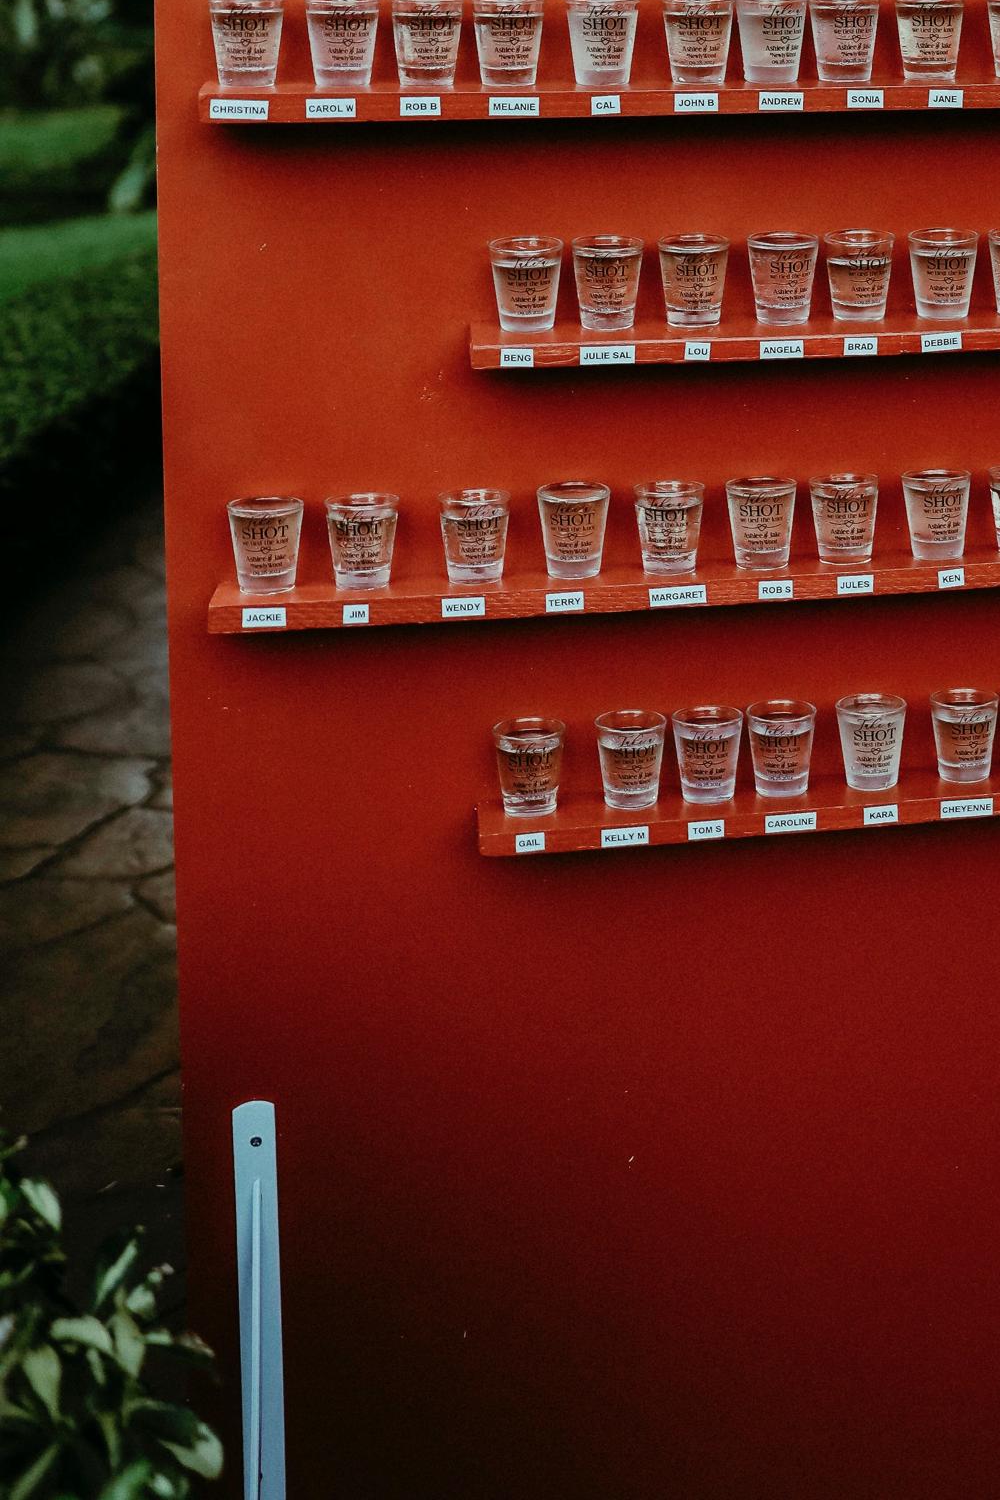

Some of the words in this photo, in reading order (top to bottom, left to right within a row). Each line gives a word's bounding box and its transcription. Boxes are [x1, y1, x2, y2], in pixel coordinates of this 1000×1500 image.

[223, 19, 269, 31] SHOT
[325, 18, 370, 30] SHOT
[492, 17, 534, 30] SHOT
[583, 18, 627, 30] SHOT
[678, 17, 722, 29] SHOT
[763, 16, 802, 29] SHOT
[912, 15, 954, 27] SHOT
[678, 99, 705, 107] JOHN
[761, 97, 801, 106] ANDREW
[851, 95, 881, 104] SONIA
[932, 95, 958, 103] JANE
[212, 105, 266, 115] CHRISTINA
[308, 104, 344, 113] CAROL
[405, 102, 428, 111] ROB
[493, 102, 536, 111] MELANIE
[595, 101, 616, 110] CAL
[770, 260, 812, 273] SHOT
[927, 257, 968, 270] SHOT
[508, 269, 550, 281] SHOT
[676, 264, 719, 277] SHOT
[847, 342, 874, 351] BRAD
[924, 337, 959, 348] DEBBIE
[687, 347, 708, 356] LOU
[763, 345, 802, 354] ANGELA
[503, 354, 532, 362] BENG
[583, 351, 610, 360] JULIE
[612, 351, 632, 359] SAL
[923, 494, 963, 507] SHOT
[739, 504, 783, 517] SHOT
[550, 512, 596, 526] SHOT
[242, 525, 289, 540] SHOT
[942, 574, 961, 584] KEN
[762, 586, 783, 594] ROB
[839, 580, 870, 590] JULES
[651, 590, 704, 602] MARGARET
[445, 602, 481, 612] WENDY
[548, 597, 581, 607] TERRY
[246, 613, 281, 622] JACKIE
[349, 610, 366, 619] JIM
[952, 722, 991, 736] SHOT
[854, 728, 896, 741] SHOT
[687, 740, 728, 755] SHOT
[943, 803, 991, 814] CHEYENNE
[869, 810, 895, 820] KARA
[767, 817, 814, 828] CAROLINE
[692, 826, 713, 835] TOM
[604, 832, 635, 843] KELLY
[518, 838, 541, 848] GAIL
